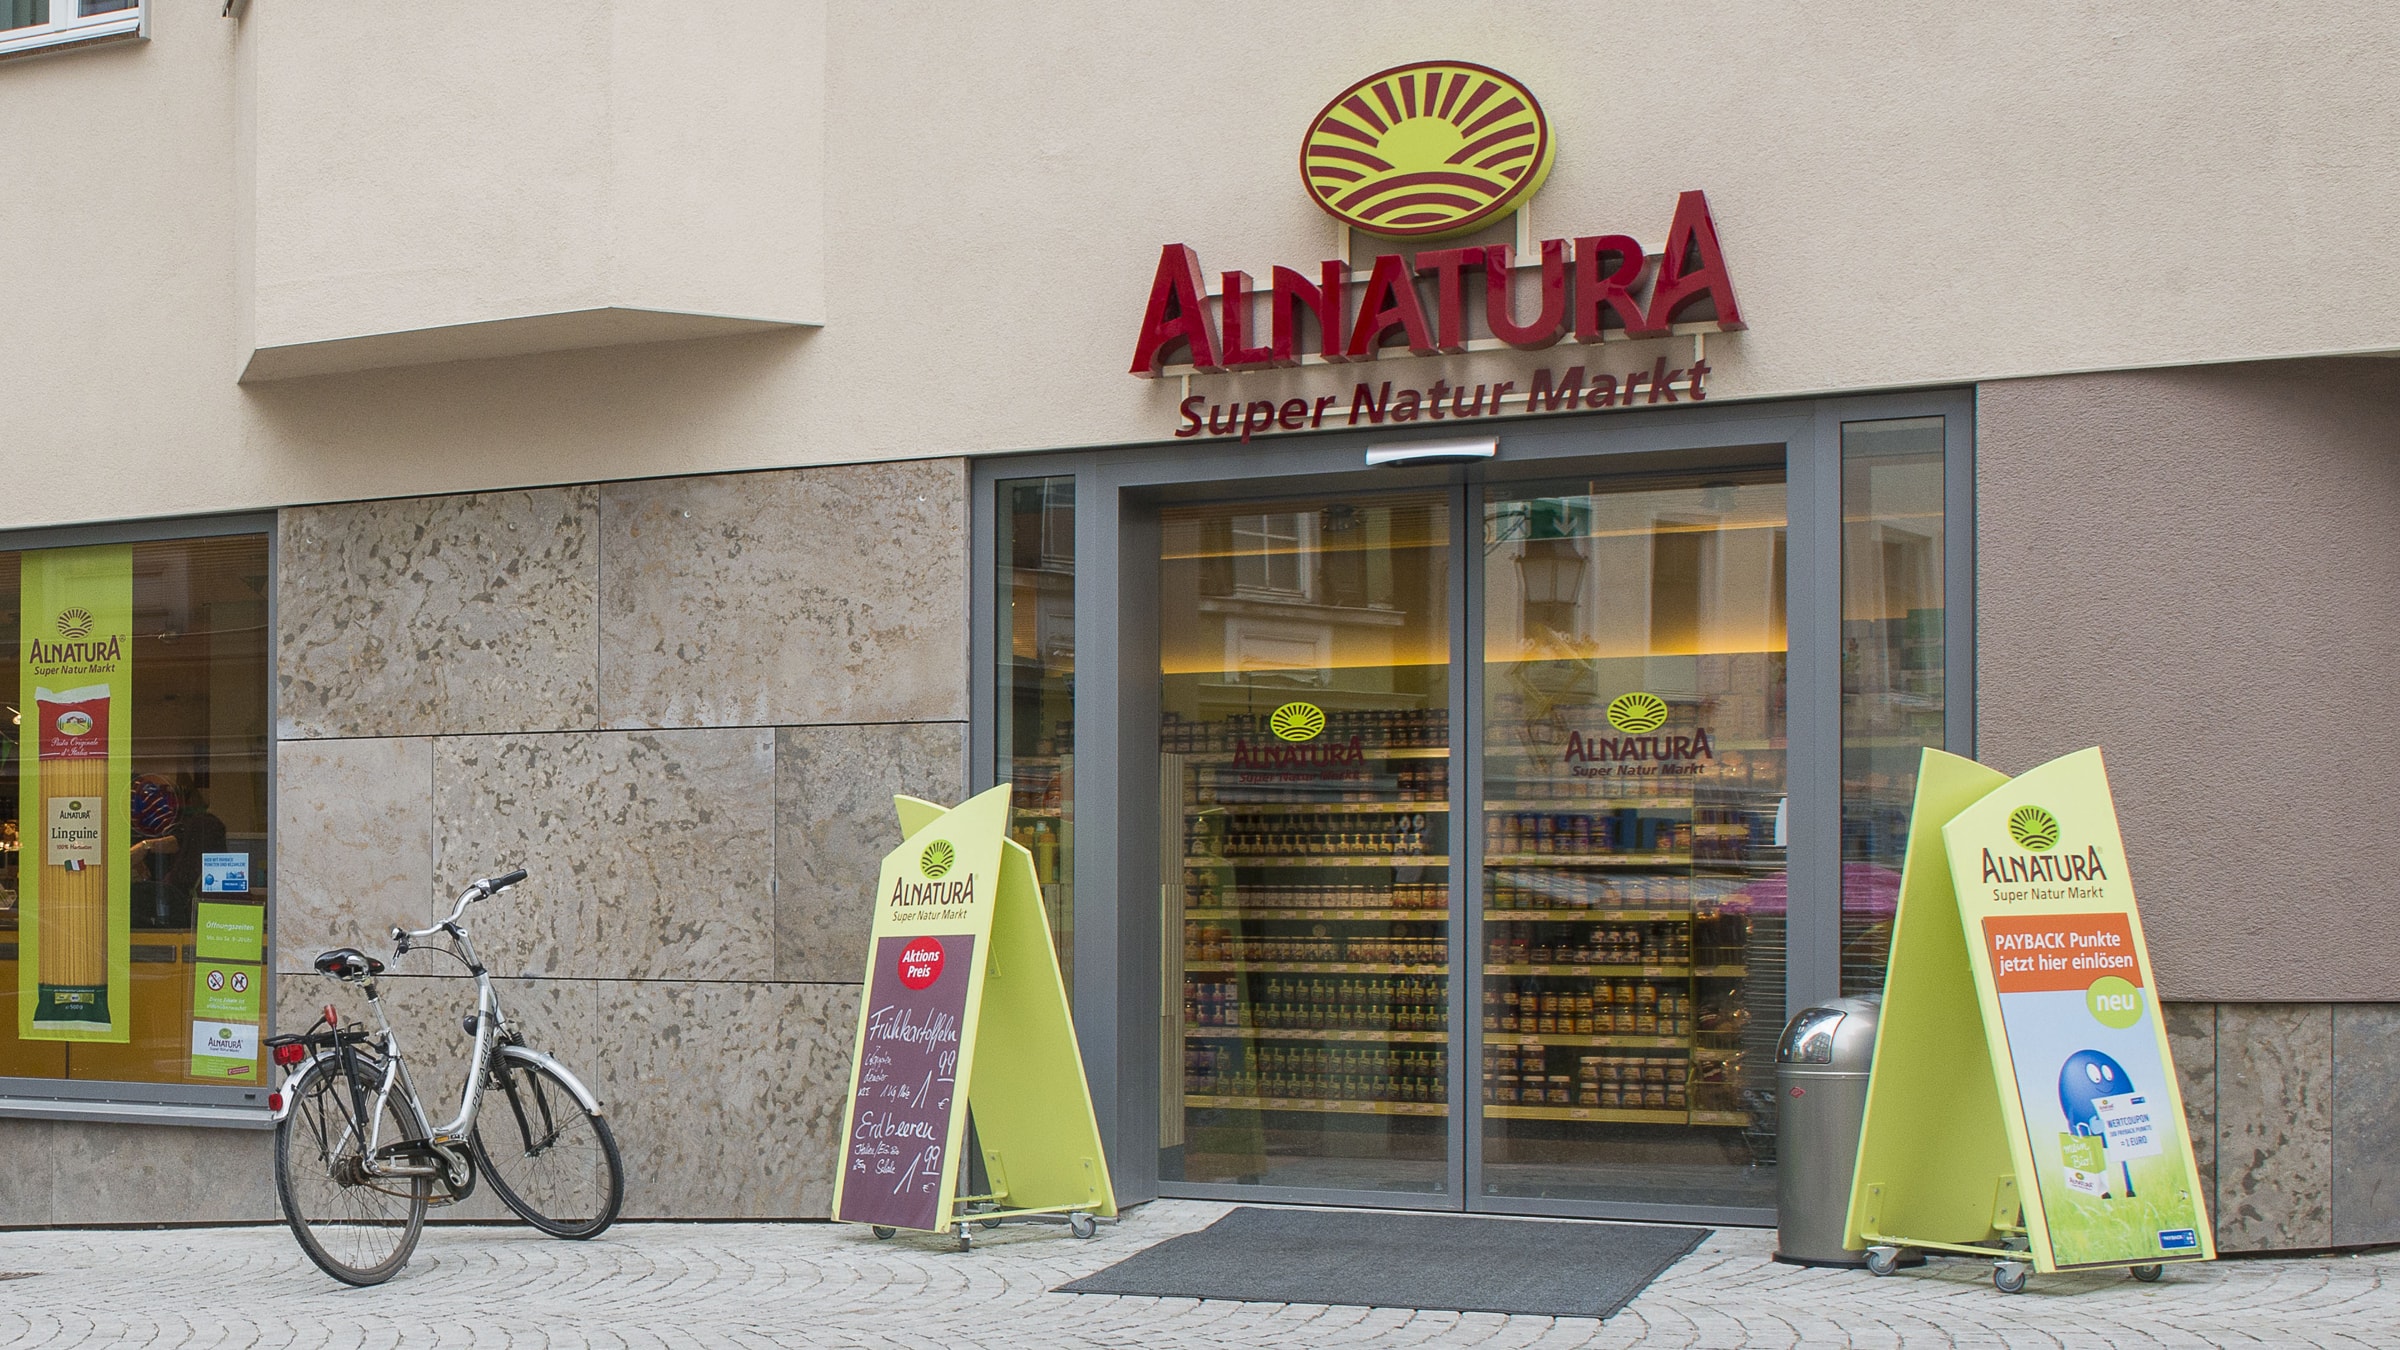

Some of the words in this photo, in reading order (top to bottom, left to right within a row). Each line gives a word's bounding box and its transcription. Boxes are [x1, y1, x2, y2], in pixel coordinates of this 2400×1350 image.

[1129, 190, 1748, 379] ALNATURA
[1174, 394, 1335, 444] Super
[1348, 378, 1515, 425] Natur
[1526, 357, 1711, 412] Markt
[30, 634, 121, 664] ALNATURA
[34, 666, 59, 677] Super
[61, 665, 88, 674] Natur
[88, 663, 116, 673] Markt
[1232, 735, 1366, 769] ALNATURA
[1564, 728, 1713, 762] ALNATURA
[1239, 772, 1275, 785] Super
[1572, 765, 1612, 778] Super
[1616, 765, 1657, 776] Natur
[1661, 763, 1705, 775] Markt
[59, 810, 90, 820] ALNATURA
[52, 826, 98, 842] Linguine
[1982, 845, 2108, 884] ALNATURA
[890, 873, 974, 907] ALNATURA
[1993, 888, 2028, 904] Super
[2031, 887, 2065, 899] Natur
[2068, 886, 2103, 898] Markt
[892, 911, 916, 923] Super
[917, 910, 940, 920] Natur
[942, 909, 967, 919] Markt
[1995, 932, 2065, 950] PAYBACK
[2069, 930, 2121, 948] Punkte
[902, 949, 940, 963] Aktions
[2000, 954, 2034, 976] jetzt
[2038, 953, 2068, 970] hier
[2072, 952, 2133, 969] einlösen
[907, 964, 931, 978] Preis
[2096, 993, 2135, 1011] neu
[870, 1005, 957, 1054] Frühkartoffeln
[208, 1037, 242, 1049] ALNATURA
[473, 1031, 491, 1110] PEGASUS
[855, 1110, 936, 1141] Erdbeeren
[2107, 1114, 2150, 1128] WERTCOUPON
[2130, 1135, 2148, 1146] EURO
